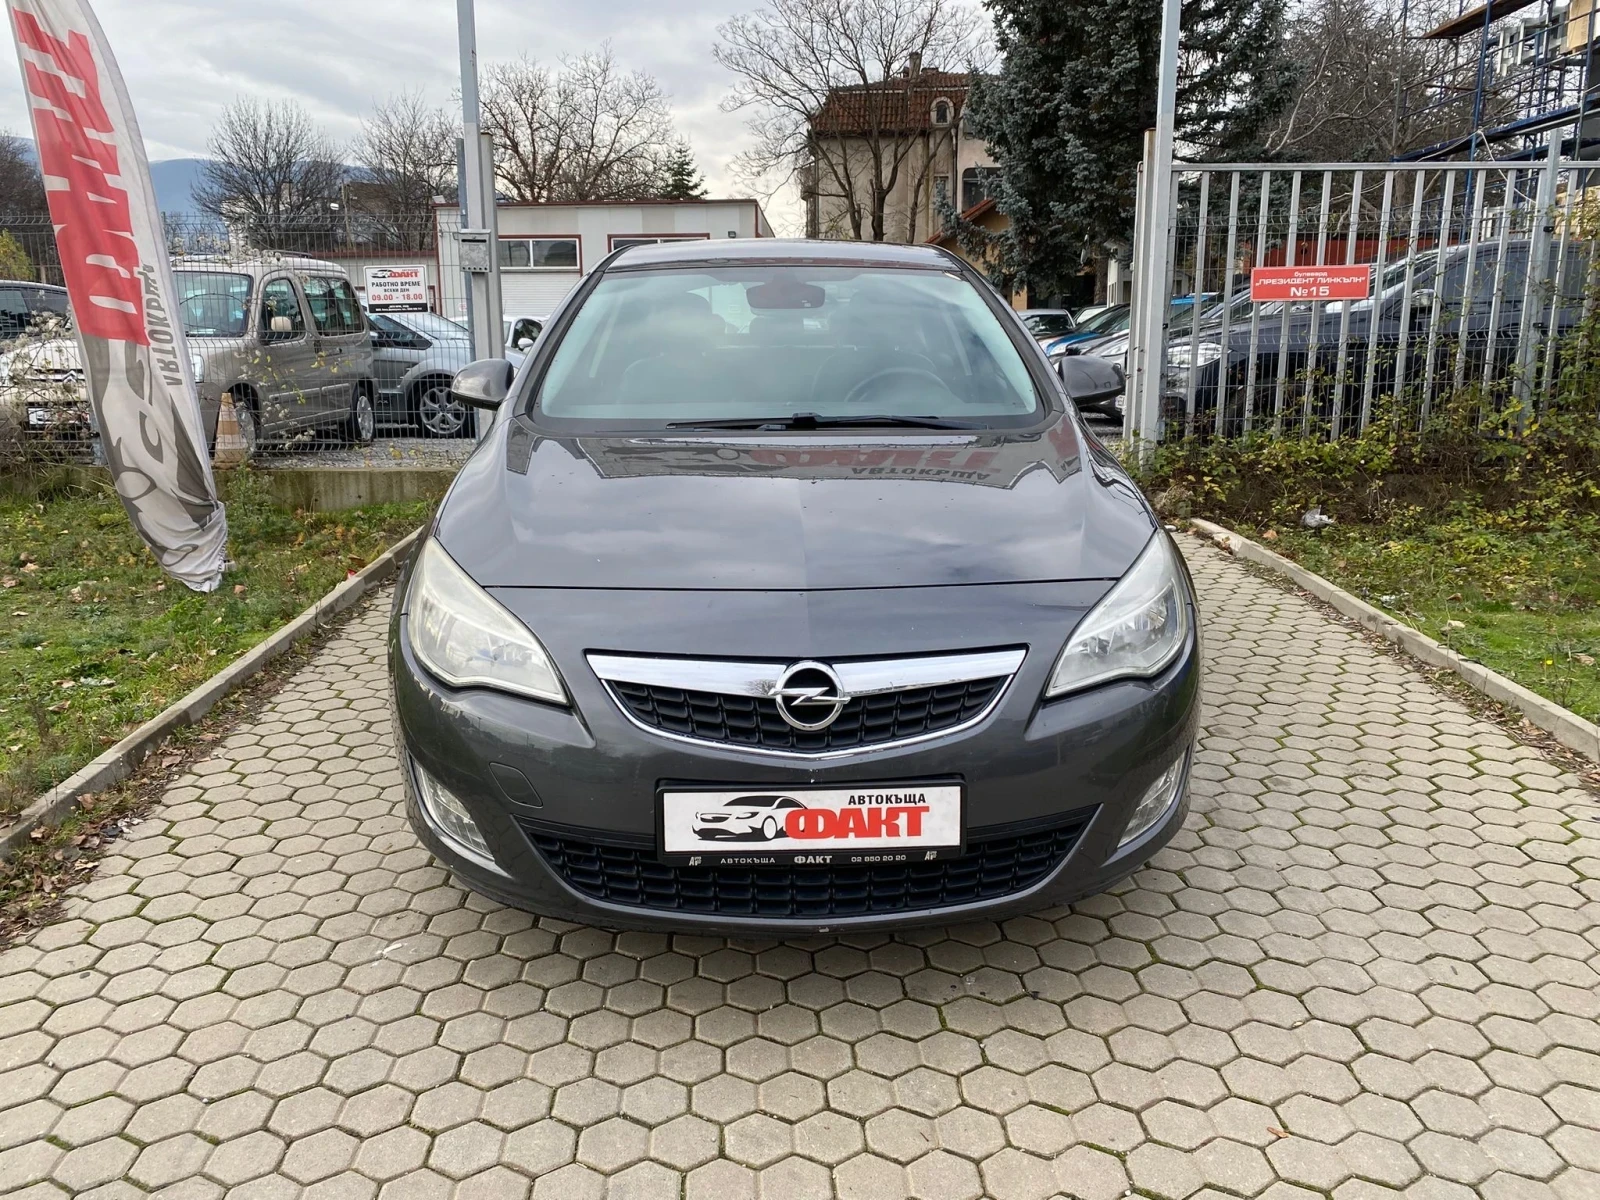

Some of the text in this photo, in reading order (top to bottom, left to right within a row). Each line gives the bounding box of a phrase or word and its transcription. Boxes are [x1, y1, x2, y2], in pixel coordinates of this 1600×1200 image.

[848, 793, 926, 805] АВТОКЪЩА
[784, 806, 930, 839] ФАКТ
[794, 855, 833, 864] ФАКТ
